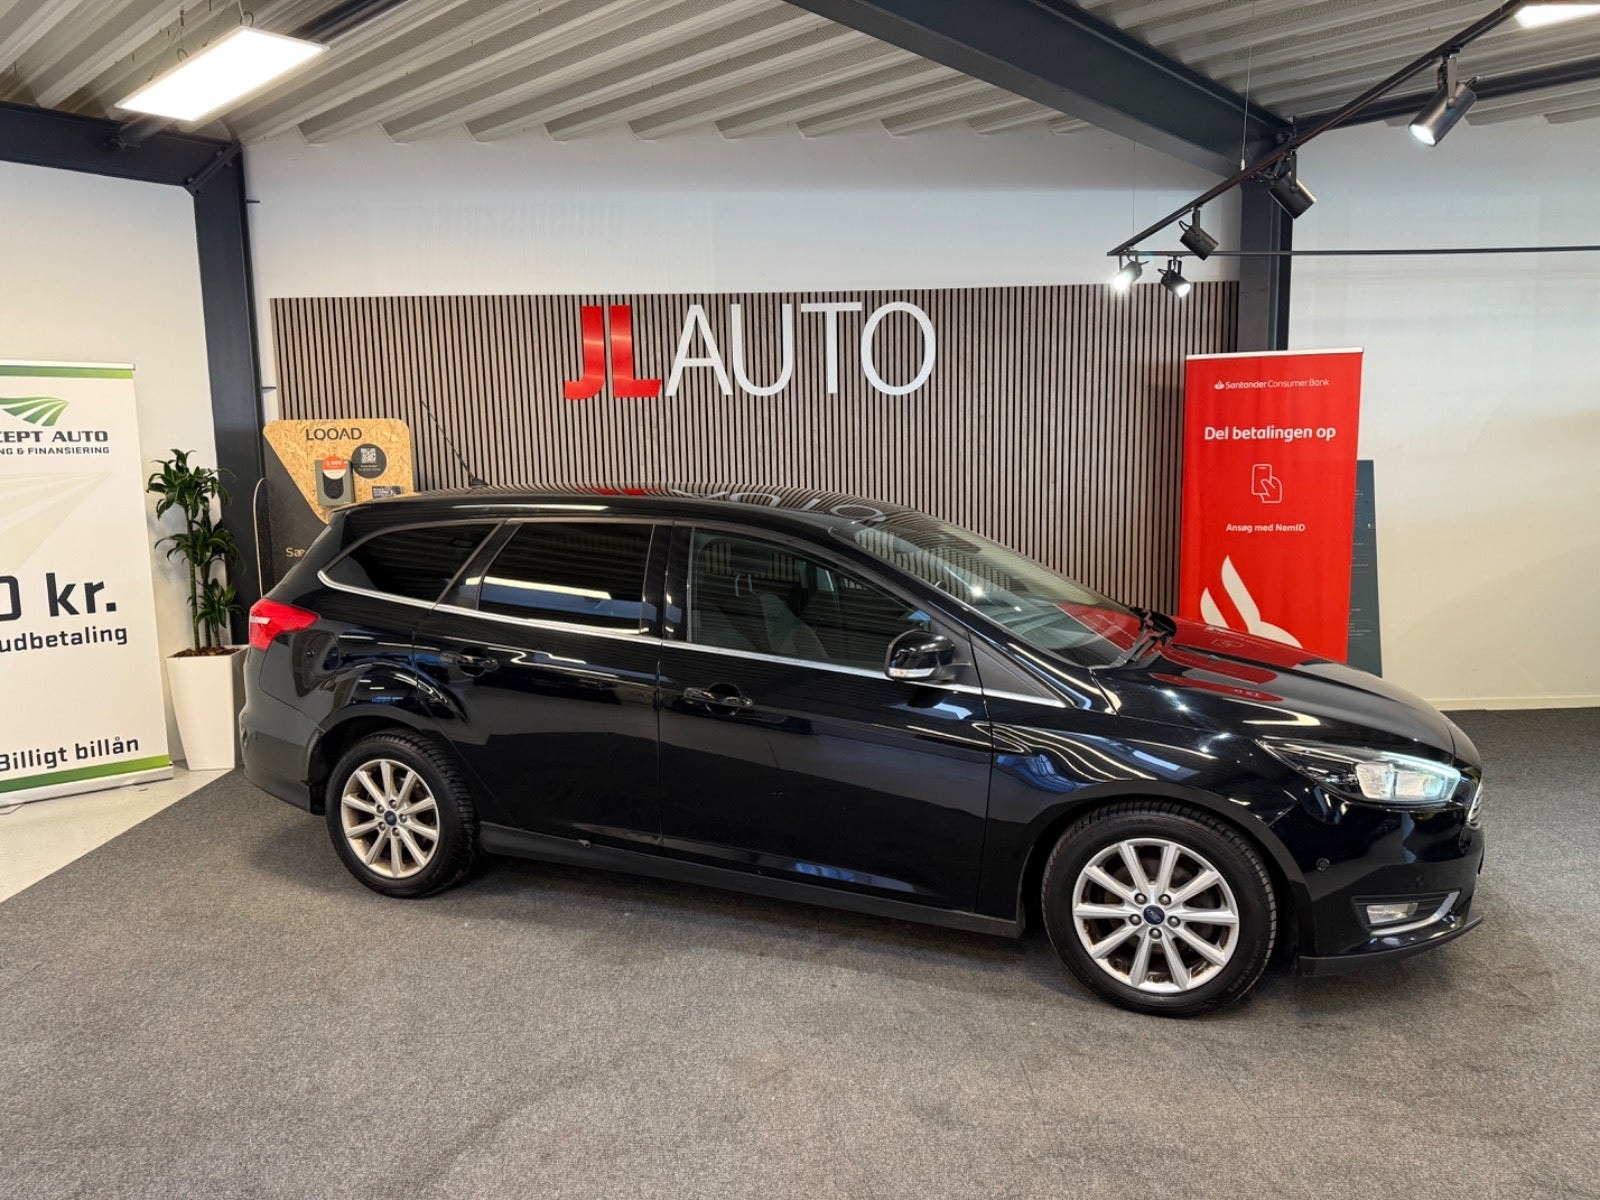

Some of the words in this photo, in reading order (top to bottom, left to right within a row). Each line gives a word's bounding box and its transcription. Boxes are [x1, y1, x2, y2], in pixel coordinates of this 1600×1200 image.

[1225, 381, 1267, 390] Santander
[1308, 378, 1330, 387] Bank
[0, 430, 43, 443] EPT
[52, 430, 108, 442] AUTO
[306, 428, 362, 440] LOOAD
[1204, 426, 1229, 440] Del
[1232, 425, 1312, 442] betalingen
[1316, 427, 1336, 442] op
[17, 447, 24, 455] &
[28, 446, 110, 455] FINANSIERING
[1226, 523, 1253, 534] Ansøg
[1254, 523, 1274, 532] med
[1275, 523, 1306, 532] NemID
[45, 572, 117, 617] kr.
[74, 736, 139, 760] billån
